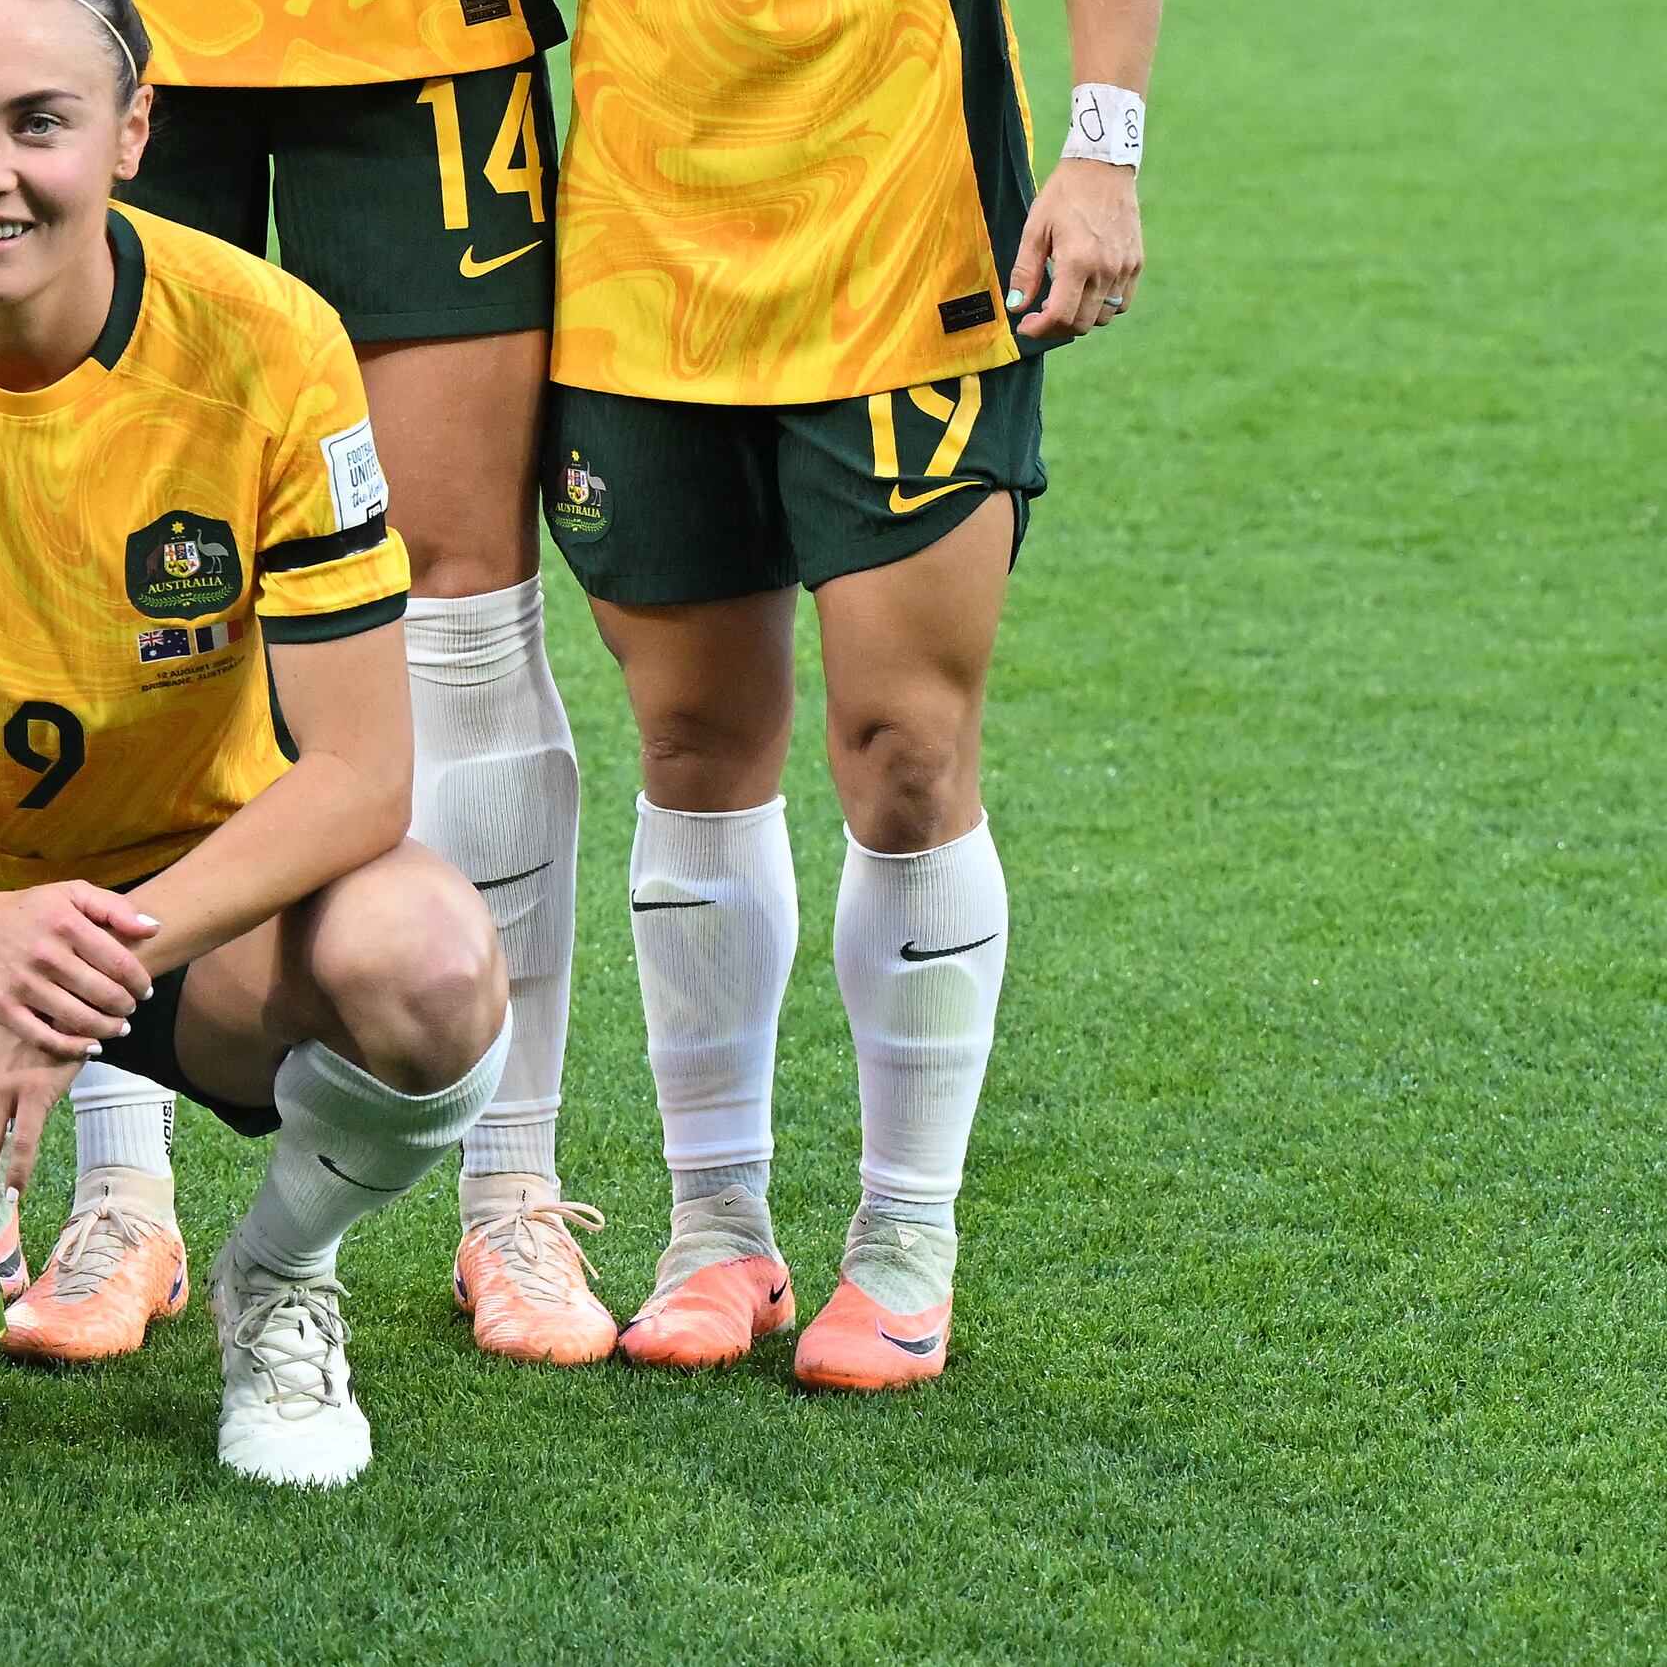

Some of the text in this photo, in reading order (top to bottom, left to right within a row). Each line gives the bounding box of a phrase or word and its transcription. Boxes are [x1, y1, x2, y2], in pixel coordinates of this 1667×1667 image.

[415, 72, 546, 231] 14
[868, 372, 982, 478] 19
[555, 502, 601, 519] AUSTRALIA
[148, 576, 224, 594] AUSTRALIA
[3, 700, 86, 810] 9
